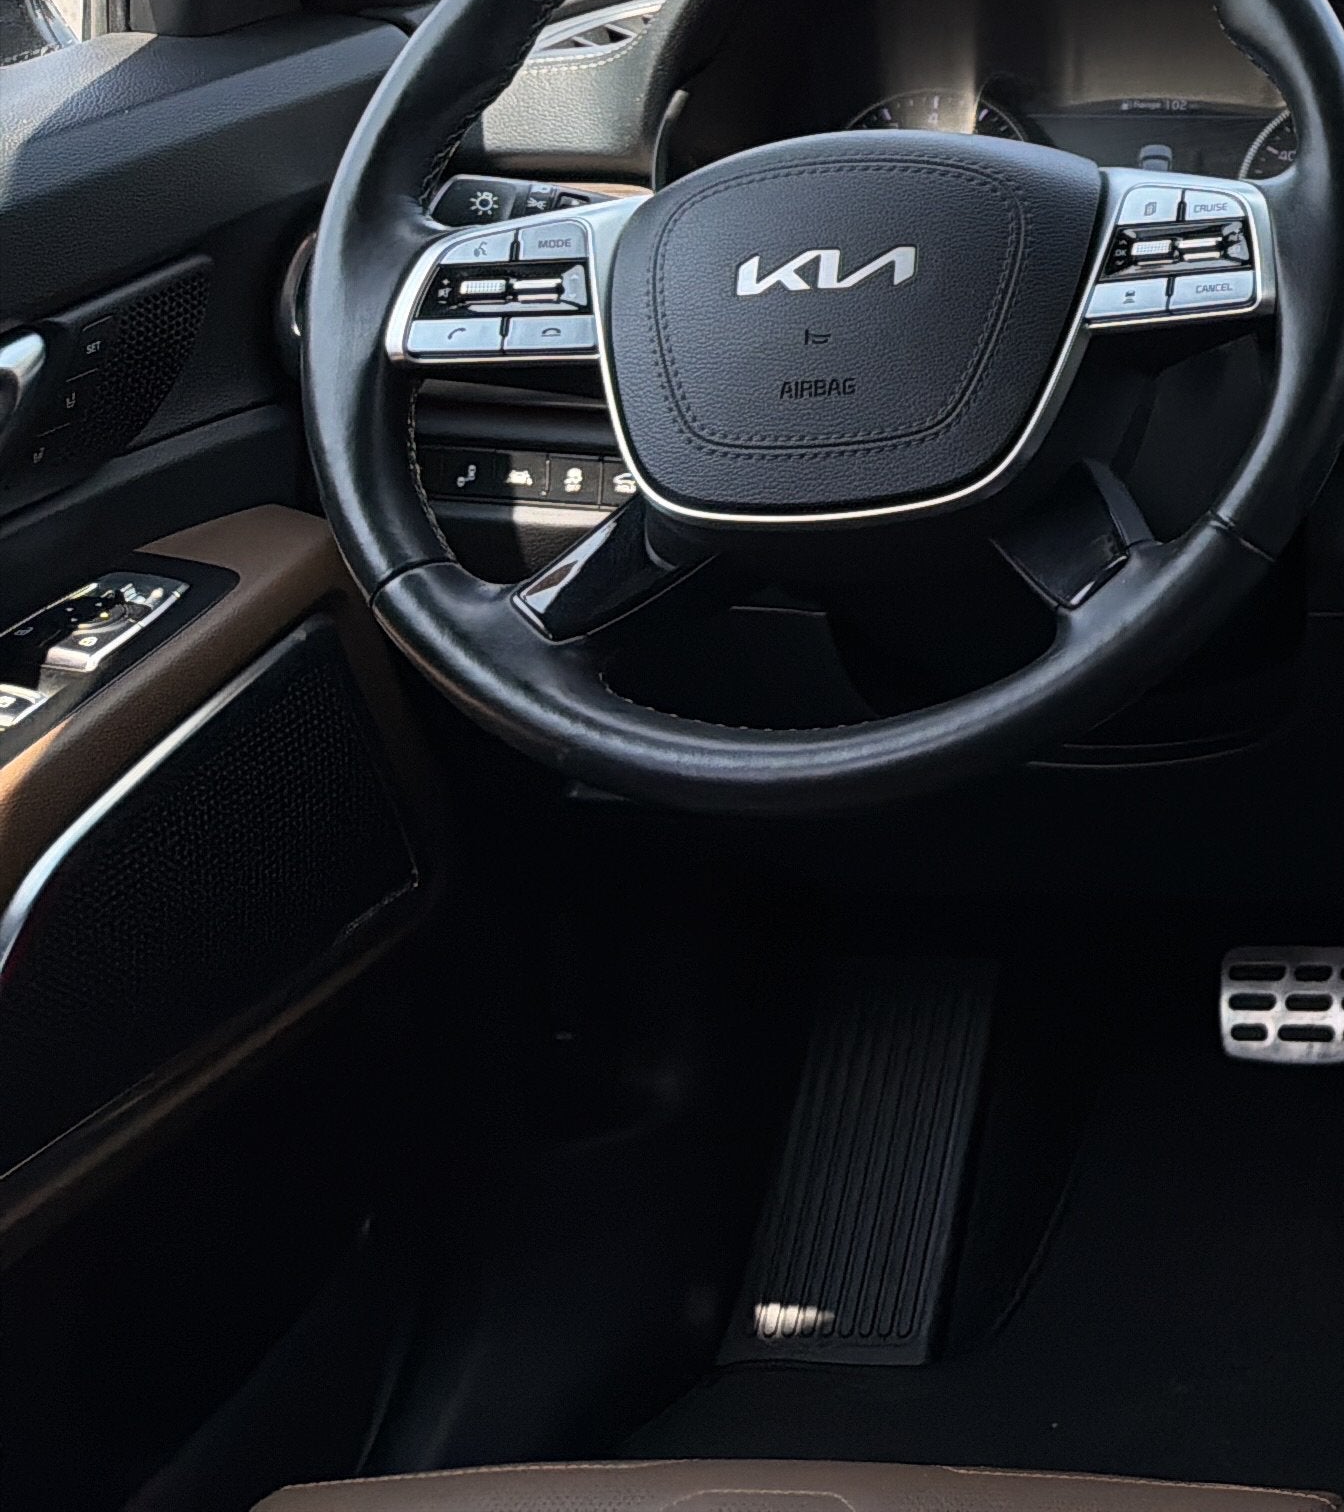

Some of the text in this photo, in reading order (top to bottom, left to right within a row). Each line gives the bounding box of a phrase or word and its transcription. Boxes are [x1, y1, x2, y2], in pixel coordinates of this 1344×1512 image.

[1193, 202, 1229, 214] CRUISE
[538, 238, 572, 249] MODE
[1195, 283, 1234, 295] CANCEL
[778, 376, 856, 401] AIRBAG
